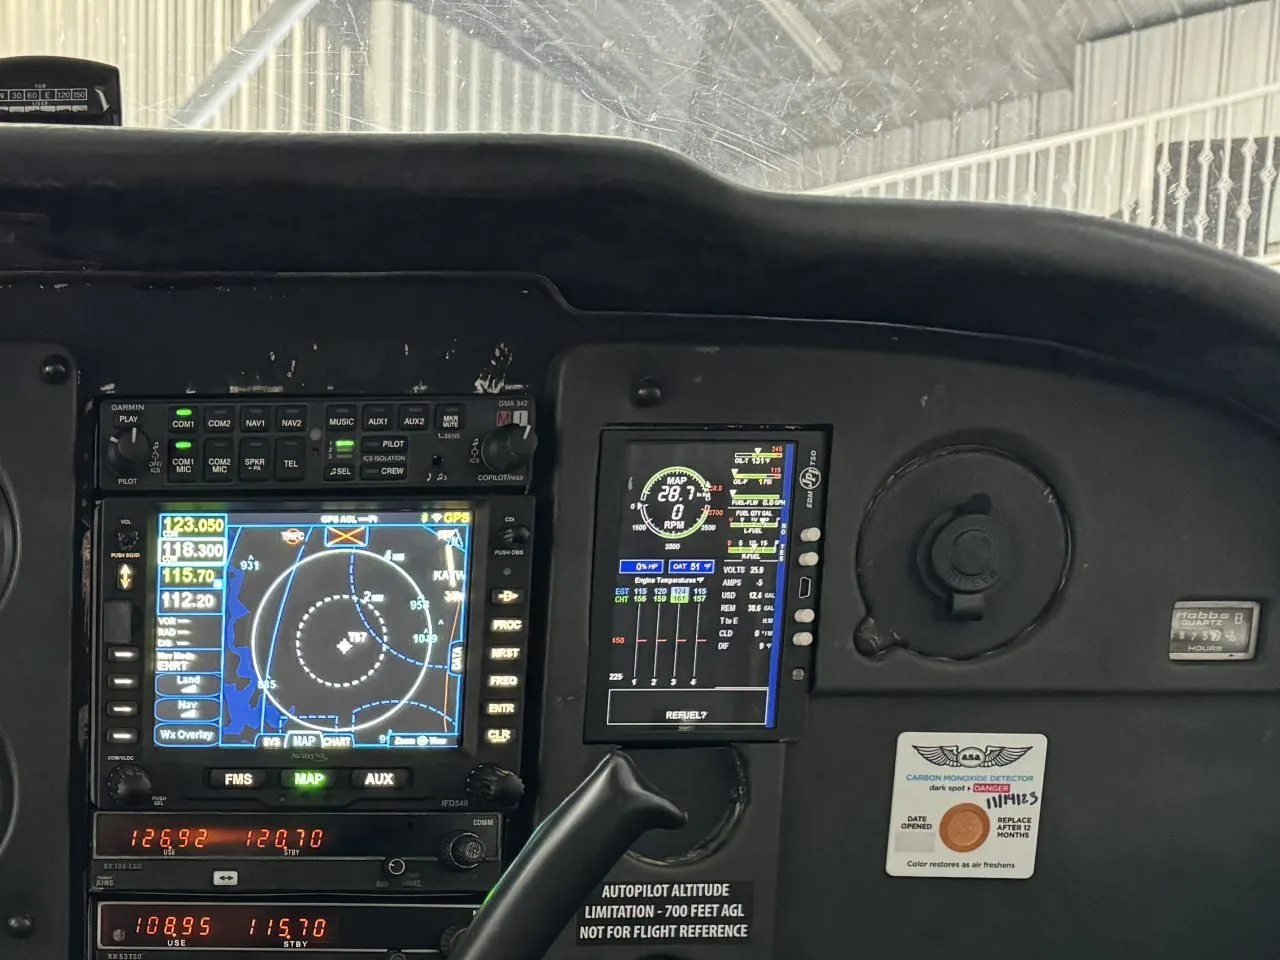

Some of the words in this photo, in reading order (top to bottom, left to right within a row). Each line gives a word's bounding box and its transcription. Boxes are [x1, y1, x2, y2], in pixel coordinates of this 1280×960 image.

[119, 416, 138, 424] PLAY
[172, 420, 195, 428] COM1
[208, 420, 232, 428] COM2
[246, 419, 266, 427] NAV1
[282, 419, 302, 427] NAV2
[330, 418, 355, 426] MUSIC
[368, 418, 388, 426] AUX1
[404, 418, 425, 426] AUX2
[383, 440, 405, 448] PILOT
[172, 458, 195, 466] COM1
[208, 458, 232, 466] COM2
[245, 458, 266, 466] SPKR
[284, 460, 299, 468] TEL
[381, 467, 405, 475] CREW
[666, 476, 688, 485] MAP
[657, 486, 695, 501] 28.7
[163, 516, 224, 532] 123.050
[664, 520, 685, 530] RPM
[163, 542, 224, 558] 118.300
[723, 566, 746, 574] VOLTS
[162, 567, 215, 584] 115.70
[161, 591, 216, 609] 112.20
[491, 619, 523, 630] PROC
[665, 711, 708, 719] REFUEL?
[159, 730, 176, 739] Wx
[177, 730, 214, 741] Overlay
[293, 736, 317, 746] MAP
[224, 773, 253, 785] FMS
[295, 773, 328, 785] MAP
[365, 773, 395, 785] AUX
[906, 774, 941, 782] CARBON
[929, 783, 947, 791] dark
[948, 784, 965, 792] spot
[974, 784, 1009, 792] DANGER
[441, 799, 469, 807] IFD540
[907, 815, 927, 823] DATE
[997, 816, 1032, 824] REPLACE
[900, 822, 933, 830] OPENED
[996, 831, 1030, 839] MONTHS
[284, 849, 301, 857] STBY
[907, 860, 928, 868] Color
[929, 860, 960, 868] restores
[961, 861, 970, 869] as
[972, 860, 981, 869] air
[983, 860, 1015, 869] freshens
[602, 884, 670, 898] AUTOPILOT
[671, 883, 731, 897] ALTITUDE
[584, 905, 655, 919] LIMITATION
[665, 905, 688, 918] 700
[690, 904, 720, 918] FEET
[721, 904, 744, 918] AGL
[579, 926, 604, 939] NOT
[607, 926, 631, 939] FOR
[633, 925, 677, 939] FLIGHT
[679, 924, 749, 939] REFERENCE
[284, 940, 309, 948] STBY
